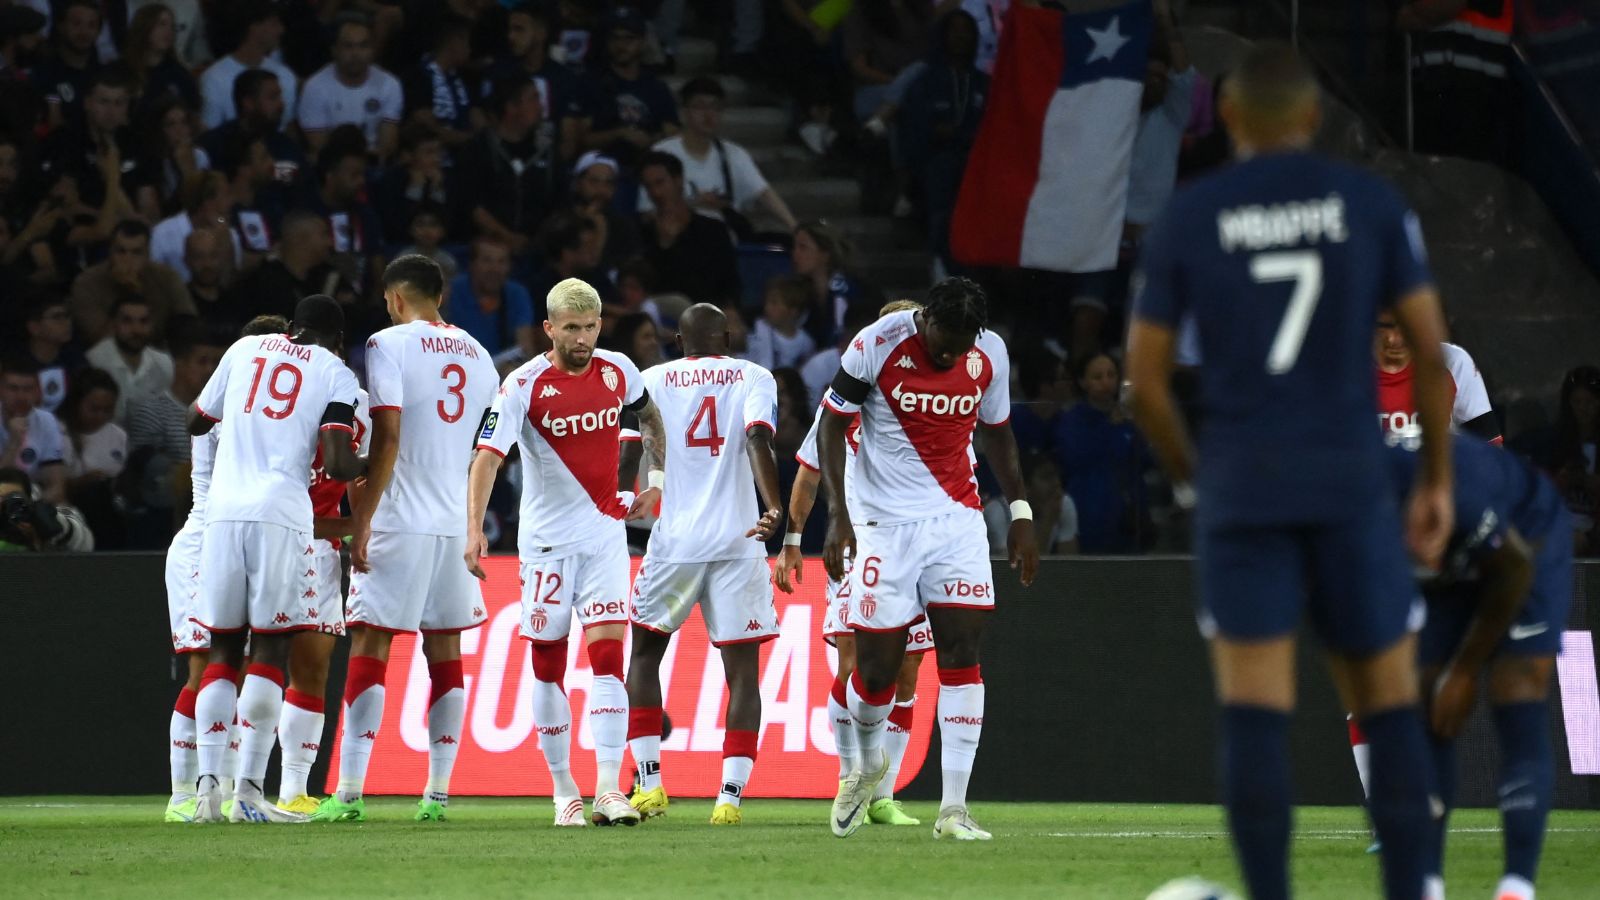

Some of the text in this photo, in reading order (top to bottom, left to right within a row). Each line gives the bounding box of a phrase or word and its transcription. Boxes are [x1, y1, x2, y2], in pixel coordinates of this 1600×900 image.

[1251, 249, 1323, 374] 7
[258, 337, 312, 363] FOFANA
[244, 357, 303, 420] 19
[665, 368, 744, 388] M.CAMARA
[437, 363, 467, 424] 3
[685, 396, 725, 457] 4
[862, 556, 882, 588] 6
[534, 570, 563, 604] 12
[943, 580, 990, 598] vbet
[583, 600, 625, 617] vbet
[944, 716, 983, 726] MONAC
[173, 740, 197, 751] MONA
